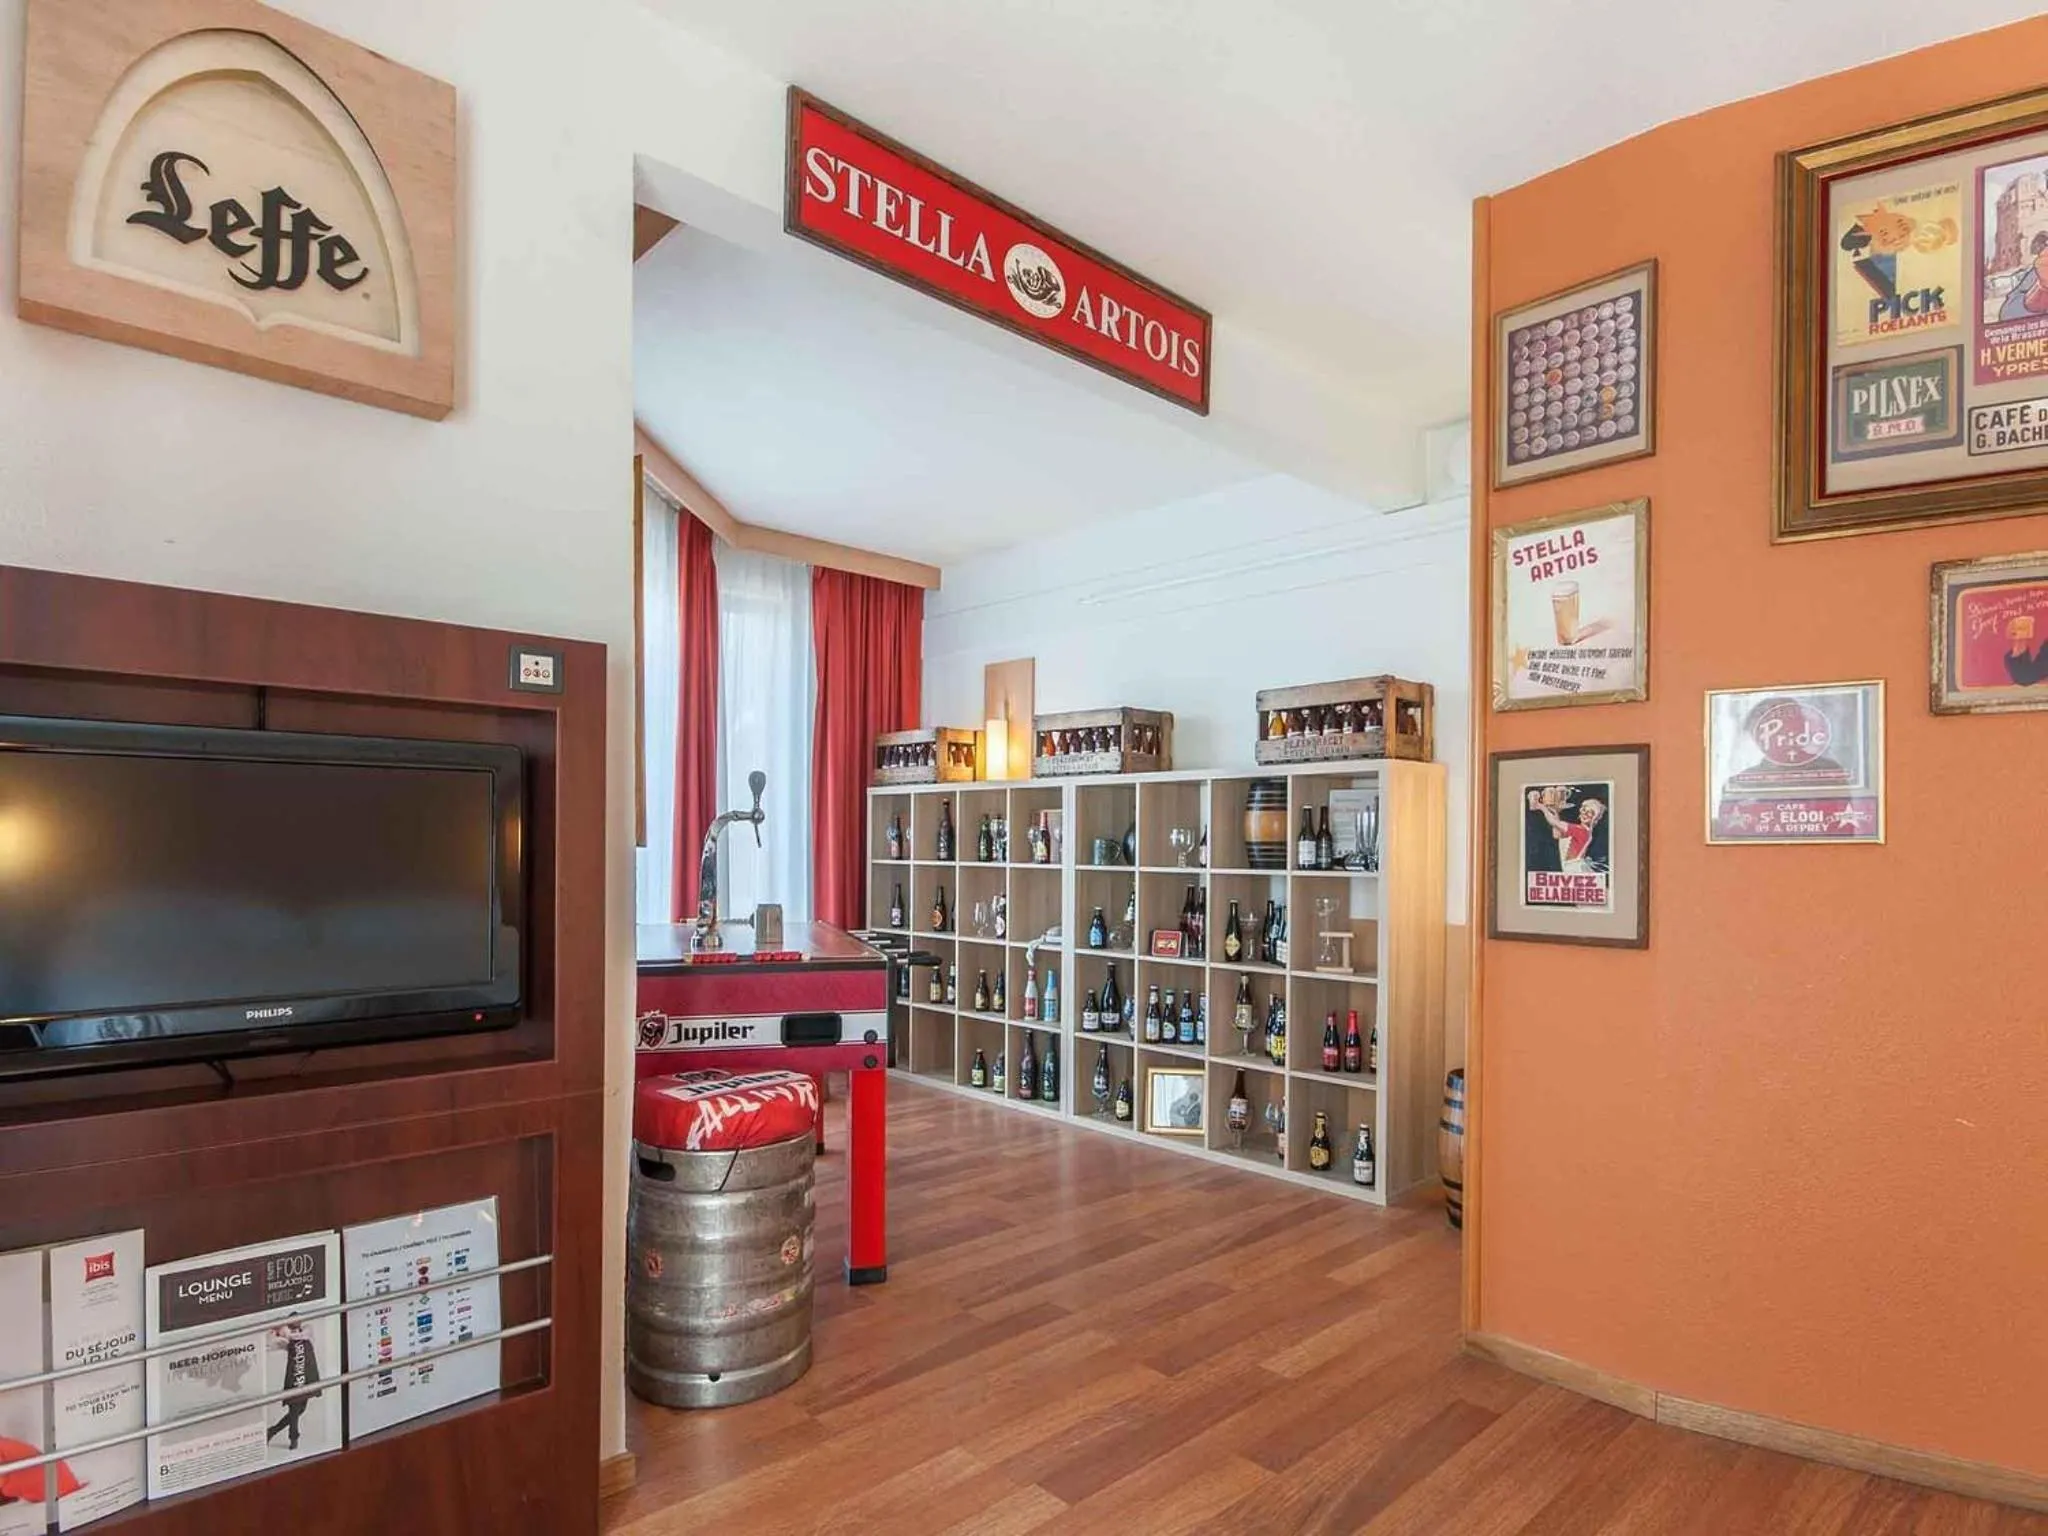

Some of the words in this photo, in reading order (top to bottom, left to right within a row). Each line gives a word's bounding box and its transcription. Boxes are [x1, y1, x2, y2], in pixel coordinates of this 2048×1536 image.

[126, 151, 369, 292] Leffe
[805, 146, 997, 282] STELLA
[1071, 285, 1201, 378] ARTOIS
[1868, 286, 1945, 323] PICK
[1868, 311, 1947, 335] ROELANTS
[1852, 375, 1942, 418] PILSEX
[1512, 530, 1585, 566] STELLA
[1530, 547, 1599, 582] ARTOIS
[1759, 718, 1826, 751] Pride
[1780, 810, 1825, 824] ELOOI
[245, 1007, 293, 1020] PHILIPS
[668, 1021, 755, 1045] Jupiler
[678, 1071, 791, 1096] Jupiler
[88, 1260, 111, 1274] ibis
[276, 1254, 314, 1279] FOOD
[178, 1271, 253, 1298] LOUNGE
[198, 1289, 233, 1305] MENU
[65, 1347, 85, 1361] DU
[168, 1356, 200, 1371] BEER
[201, 1343, 256, 1363] HOPPING
[92, 1400, 117, 1416] IBIS
